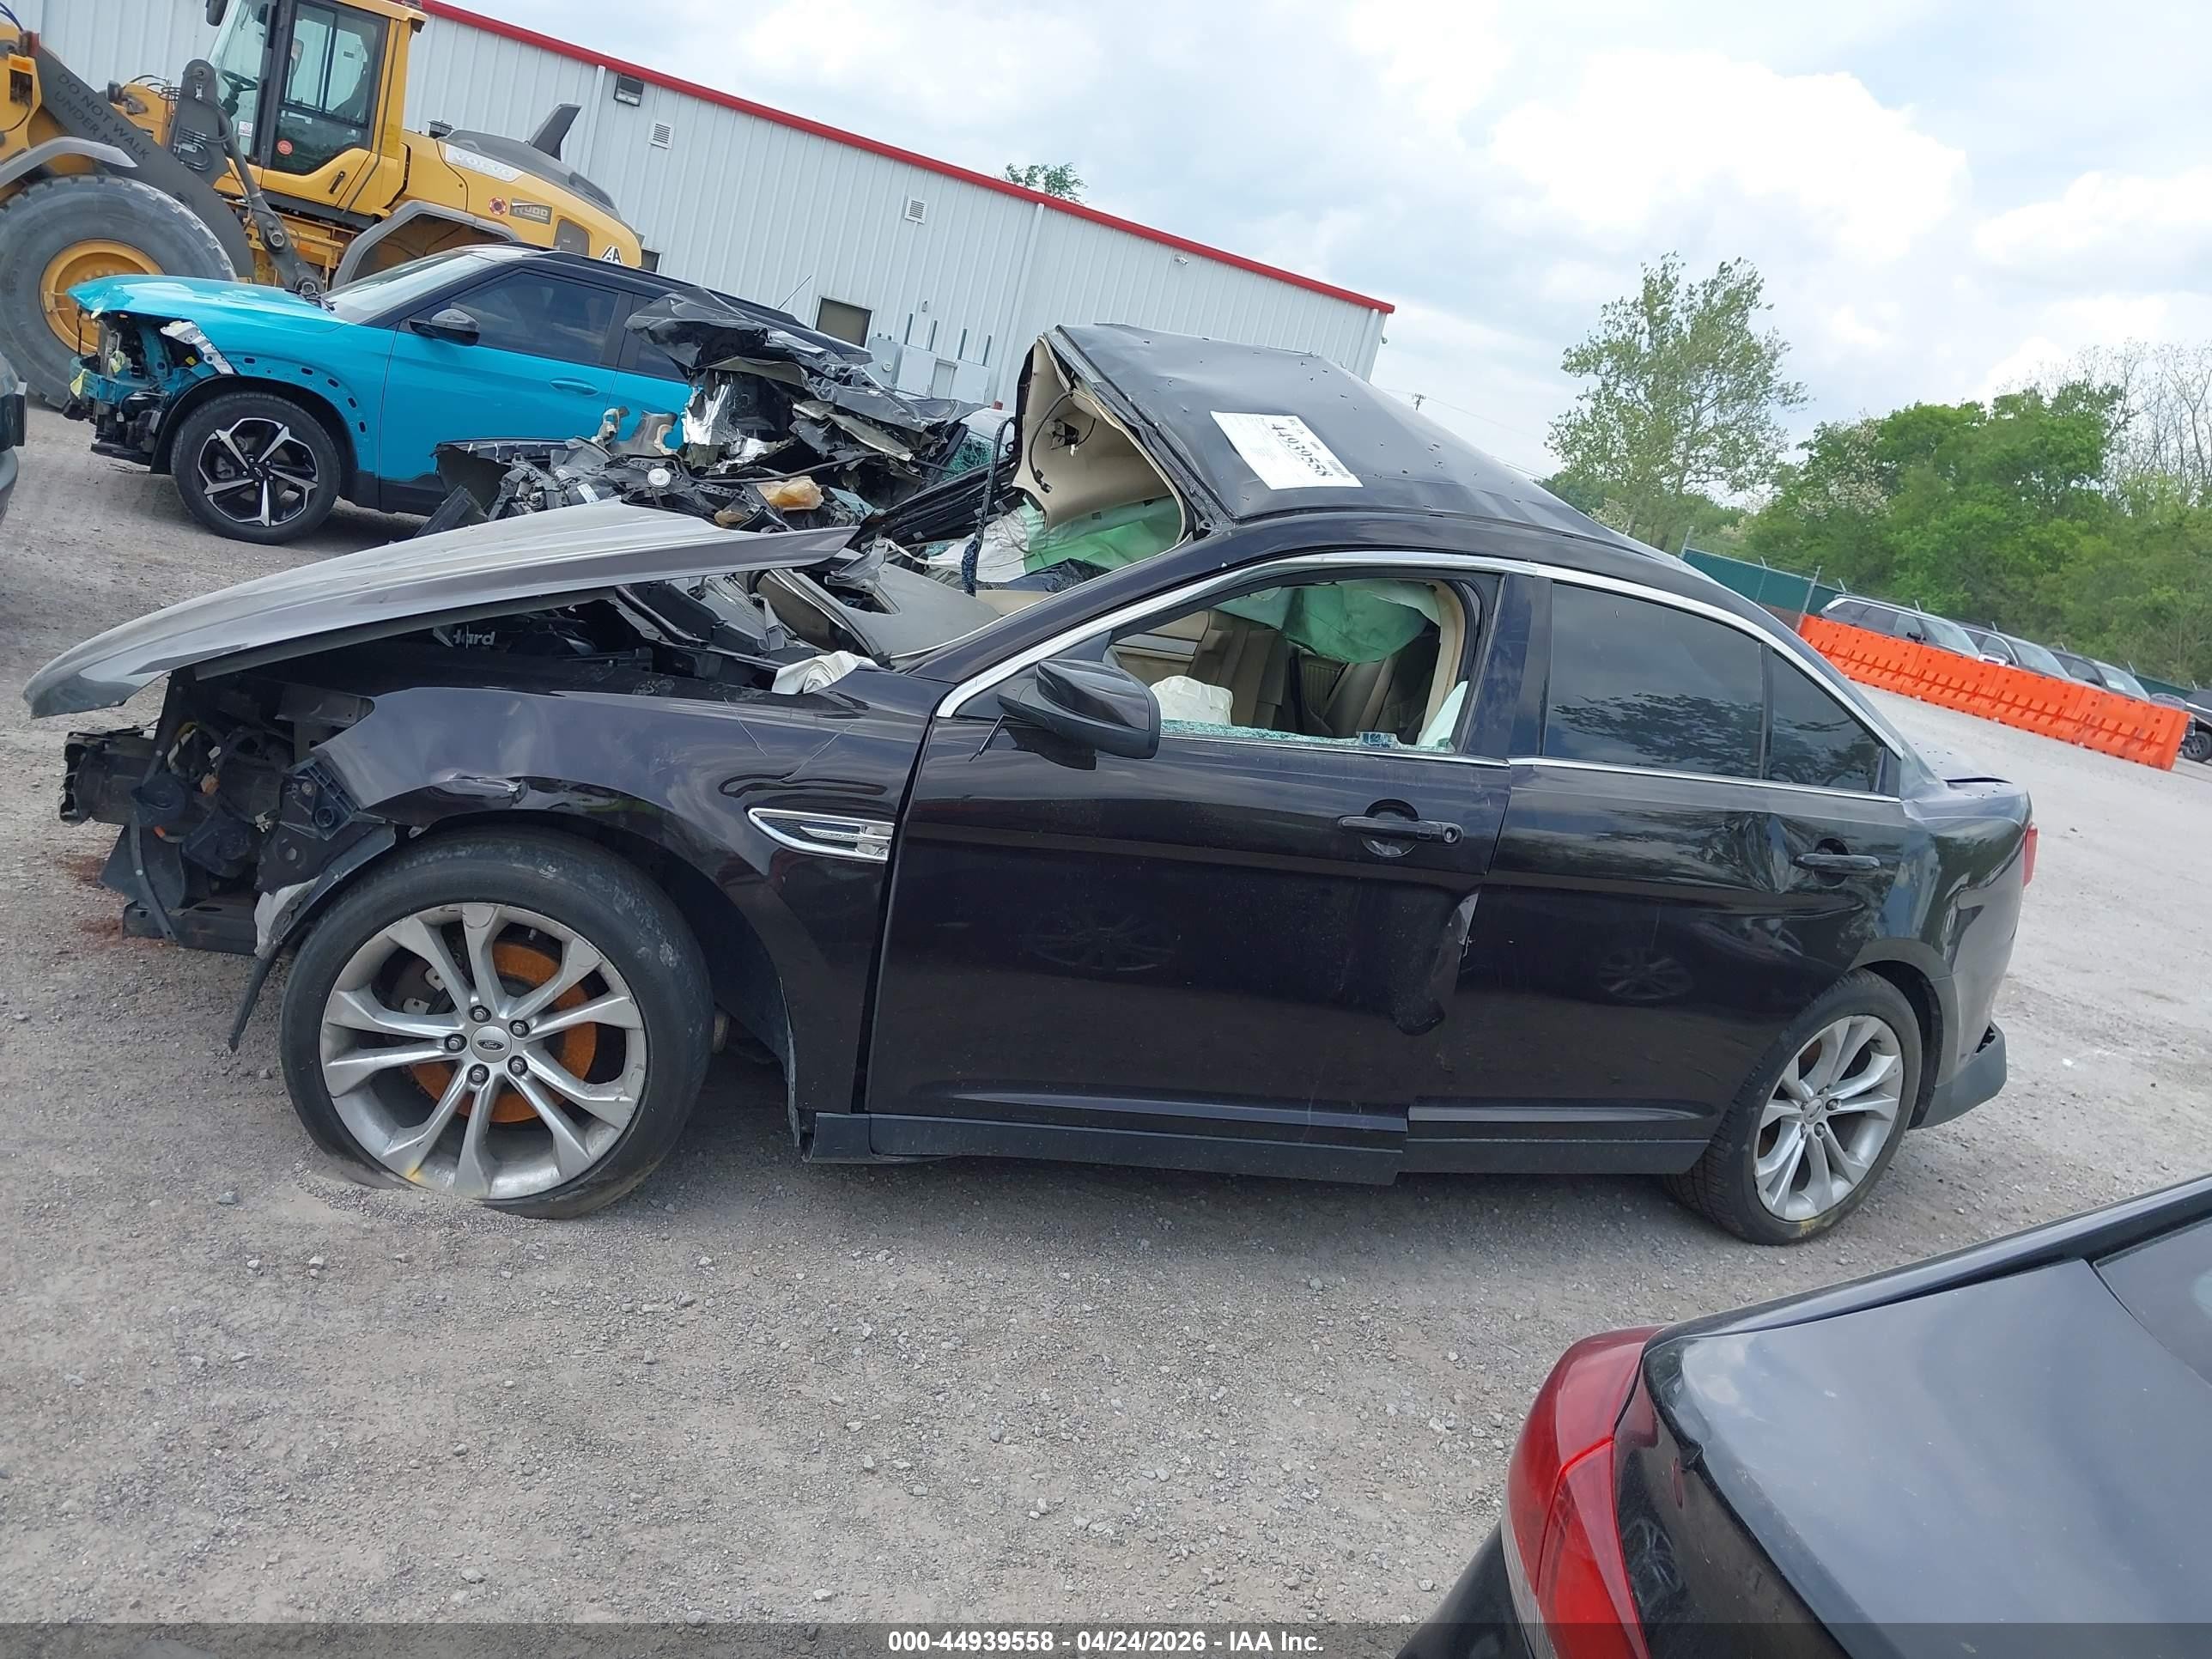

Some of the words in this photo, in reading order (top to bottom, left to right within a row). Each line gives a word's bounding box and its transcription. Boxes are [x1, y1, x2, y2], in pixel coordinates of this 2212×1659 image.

[54, 90, 100, 136] UNDER
[58, 73, 80, 94] DO
[81, 95, 113, 124] NOT
[112, 123, 150, 160] WALK
[1271, 423, 1334, 477] 44939558
